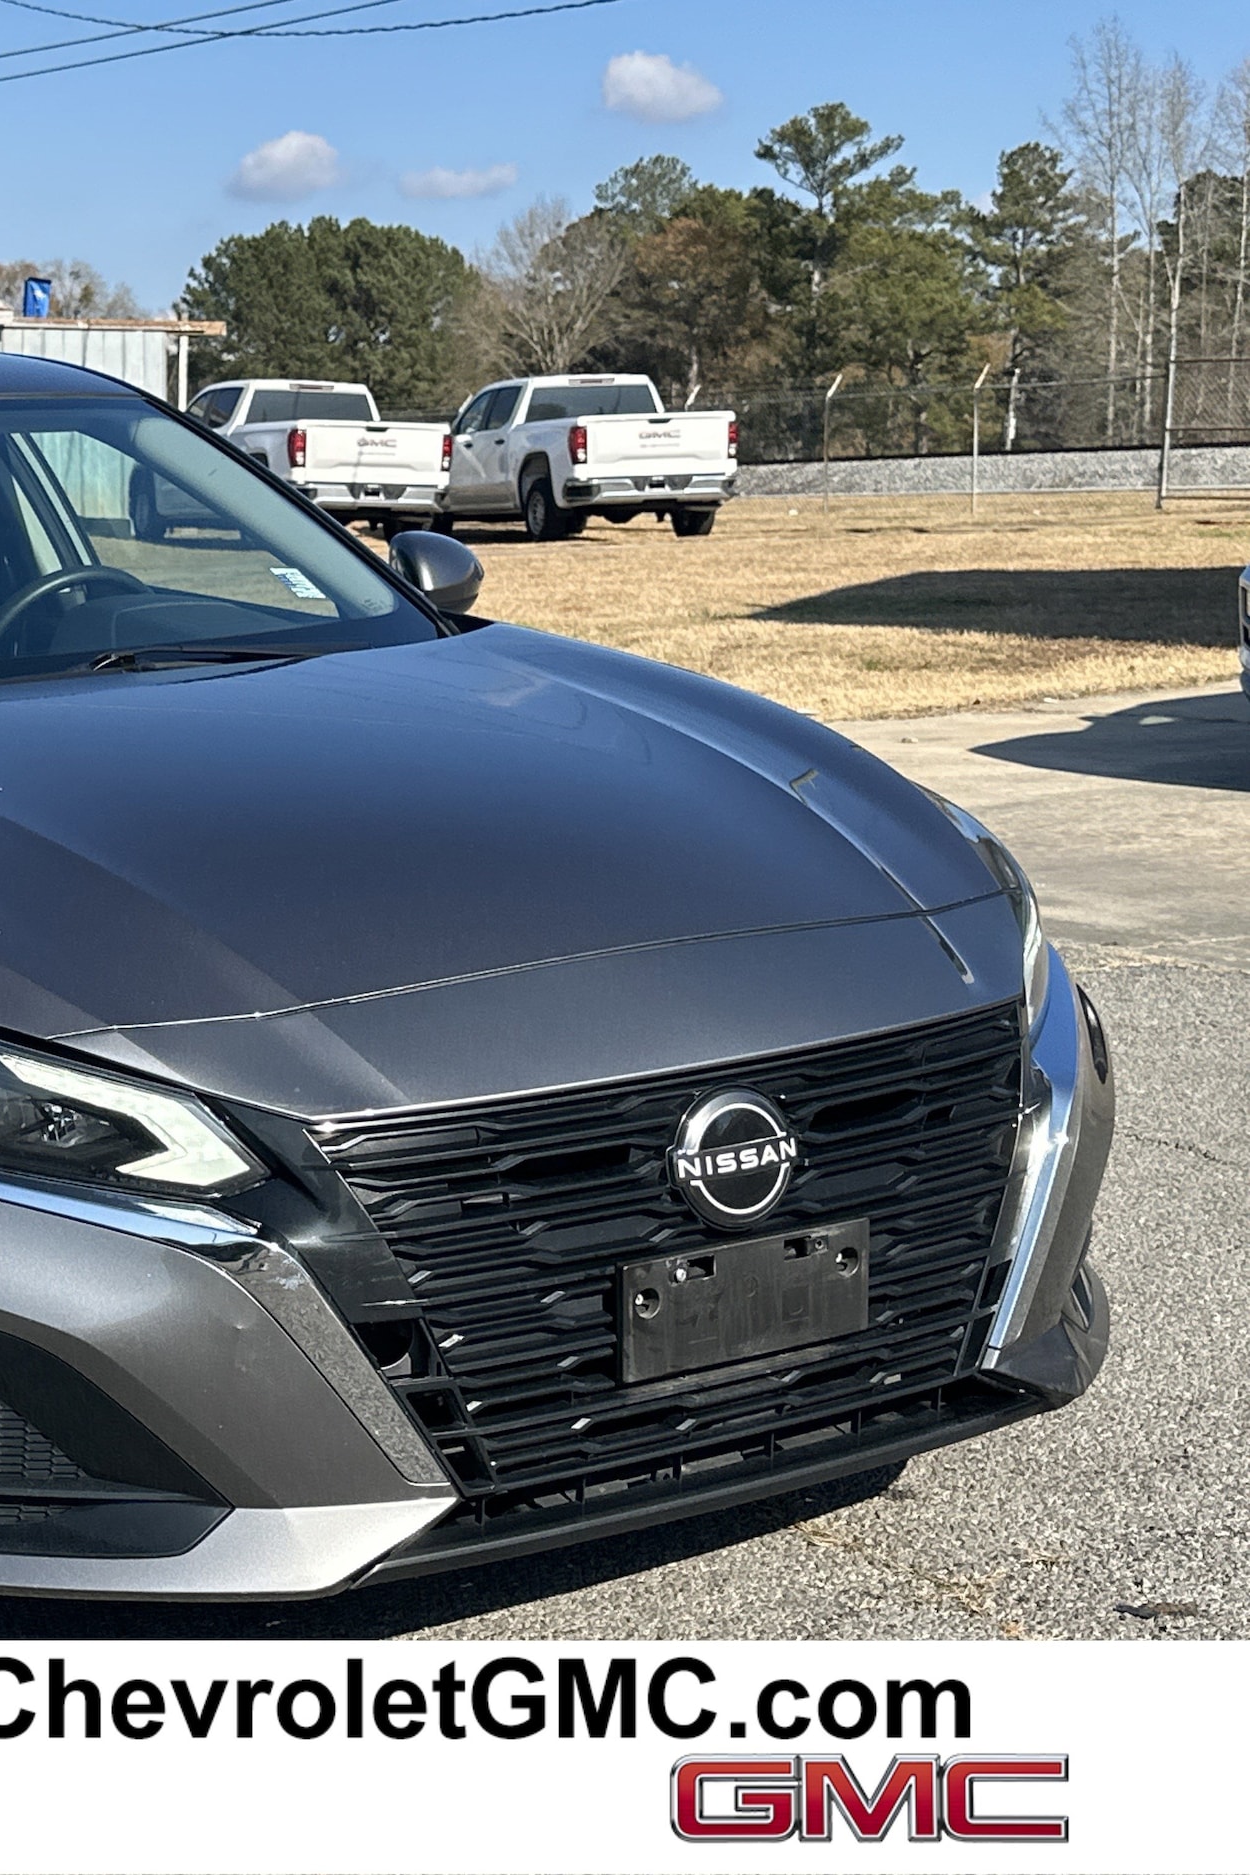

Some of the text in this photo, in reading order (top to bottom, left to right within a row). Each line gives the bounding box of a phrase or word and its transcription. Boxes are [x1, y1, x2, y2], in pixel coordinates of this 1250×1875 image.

[638, 429, 681, 439] GMC
[357, 438, 397, 448] GMC
[677, 1137, 797, 1179] NISSAN
